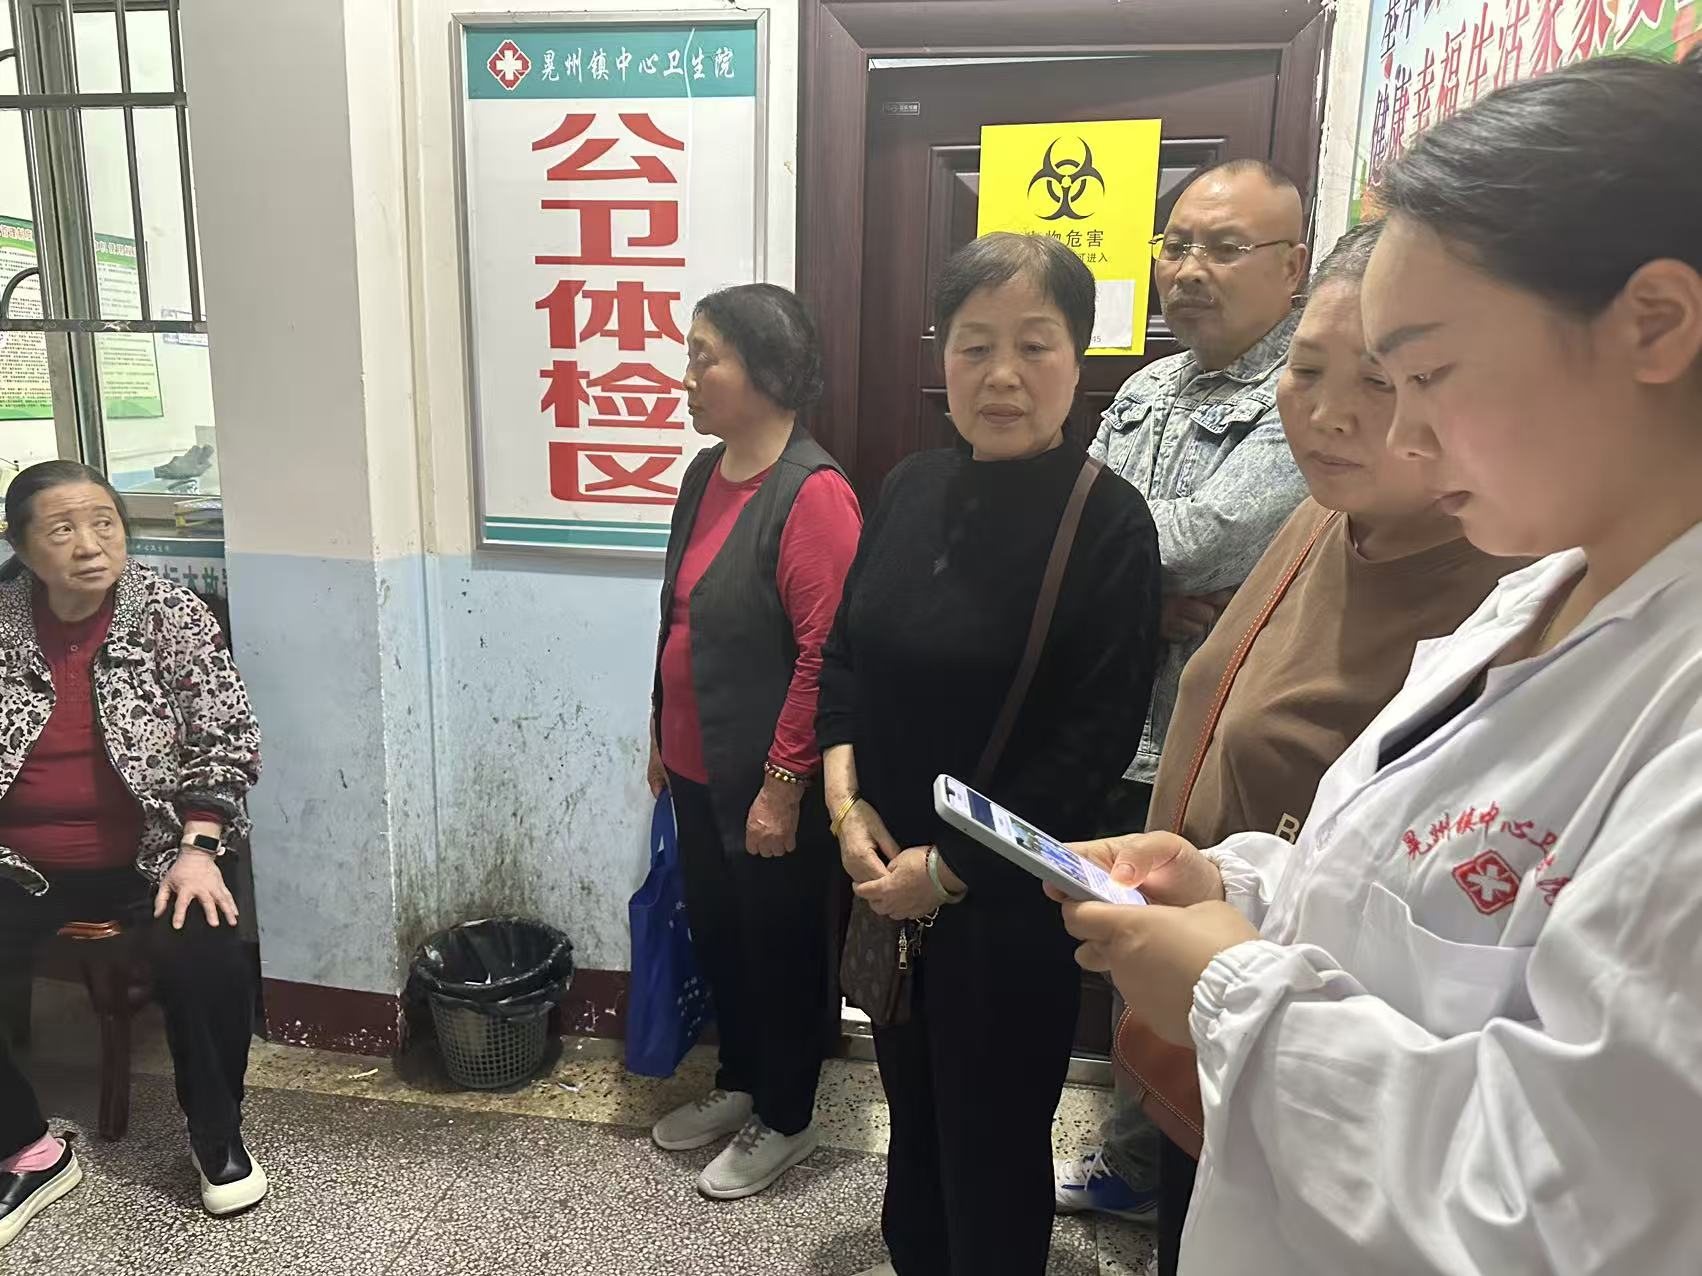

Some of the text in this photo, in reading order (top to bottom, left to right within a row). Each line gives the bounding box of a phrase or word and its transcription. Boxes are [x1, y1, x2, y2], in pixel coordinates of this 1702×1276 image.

[541, 46, 735, 83] 晃州镇中心卫生院
[532, 113, 686, 506] 公卫体检区
